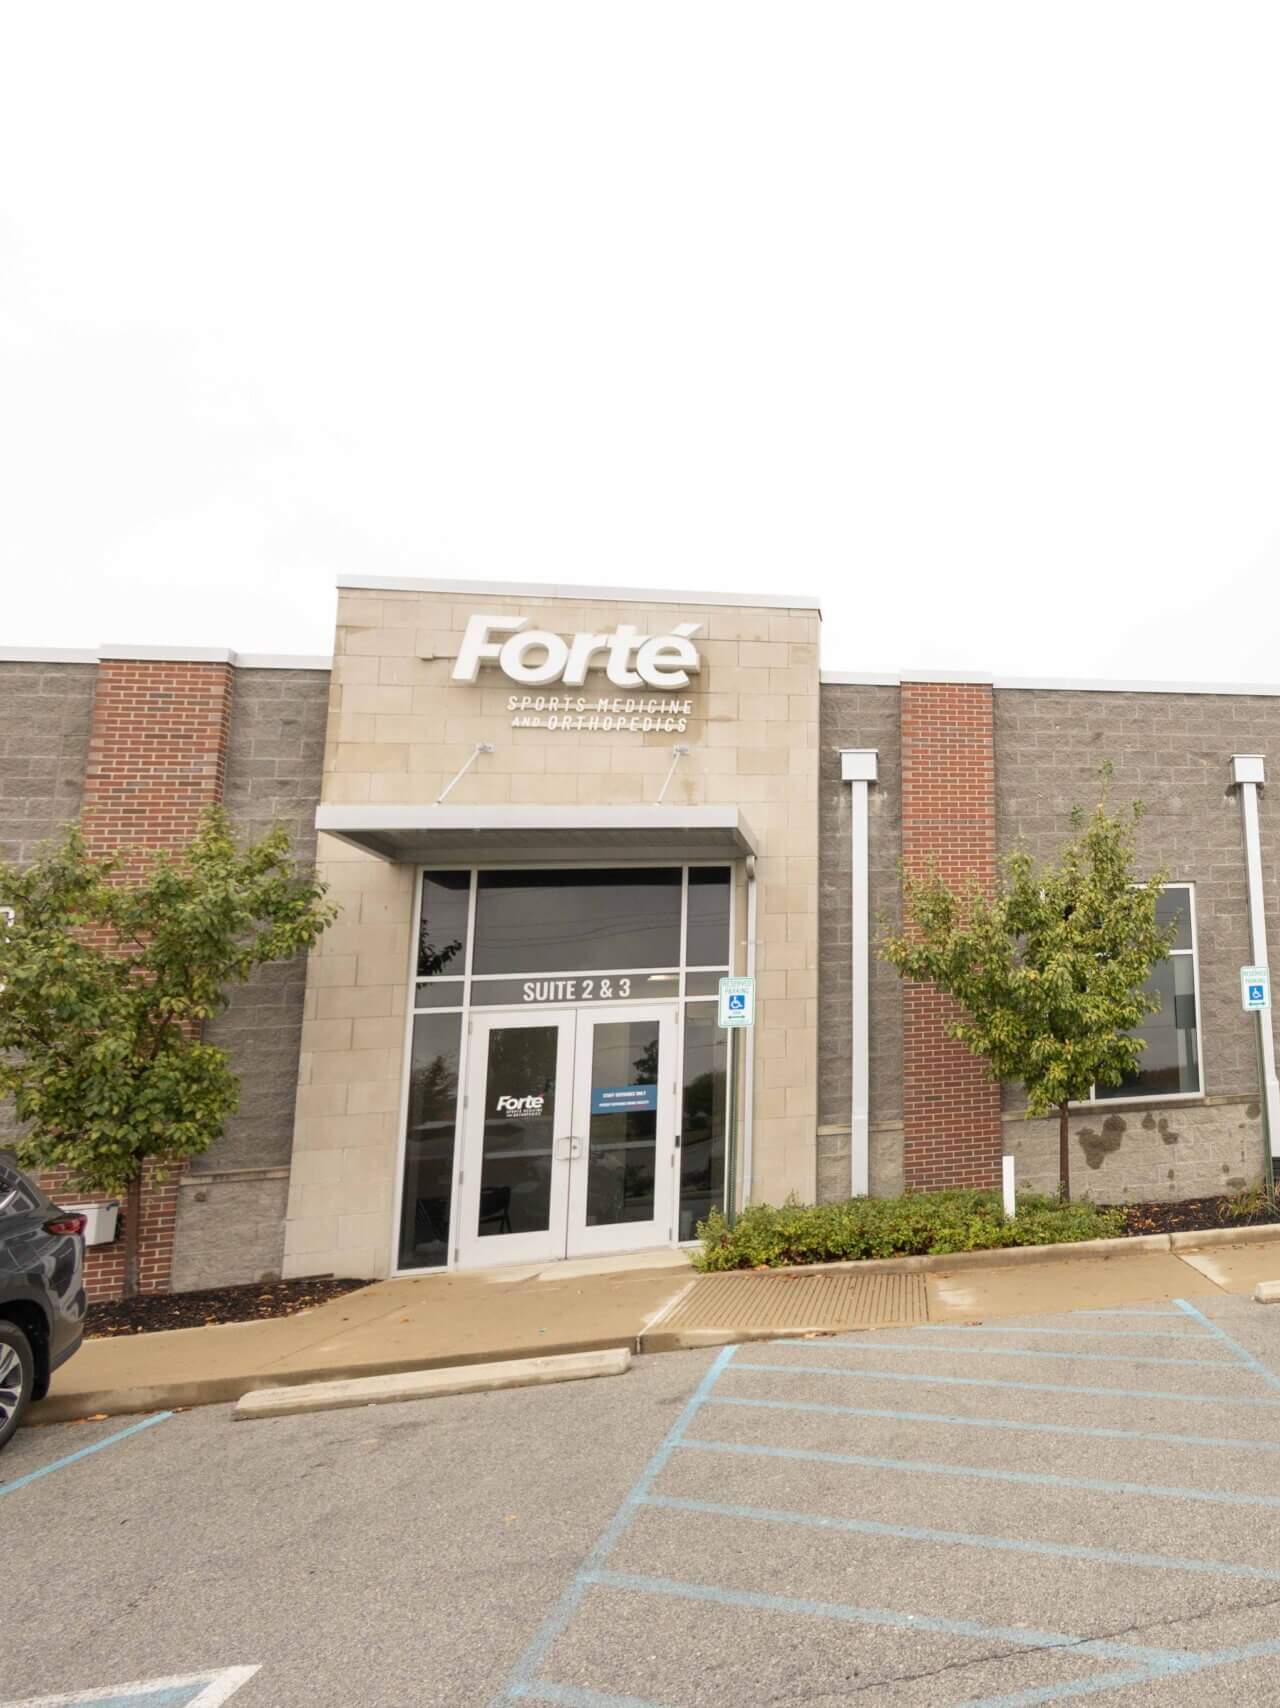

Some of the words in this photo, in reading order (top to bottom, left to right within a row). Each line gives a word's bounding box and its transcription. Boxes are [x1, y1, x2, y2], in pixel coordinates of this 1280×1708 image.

[452, 614, 703, 689] Forté
[507, 695, 586, 712] SPORTS
[597, 698, 693, 714] MEDICINE
[511, 716, 541, 728] AND
[547, 715, 687, 733] ORTHOPEDICS
[522, 980, 577, 1002] SUITE
[581, 979, 594, 999] 2
[600, 978, 613, 998] &
[618, 978, 631, 998] 3
